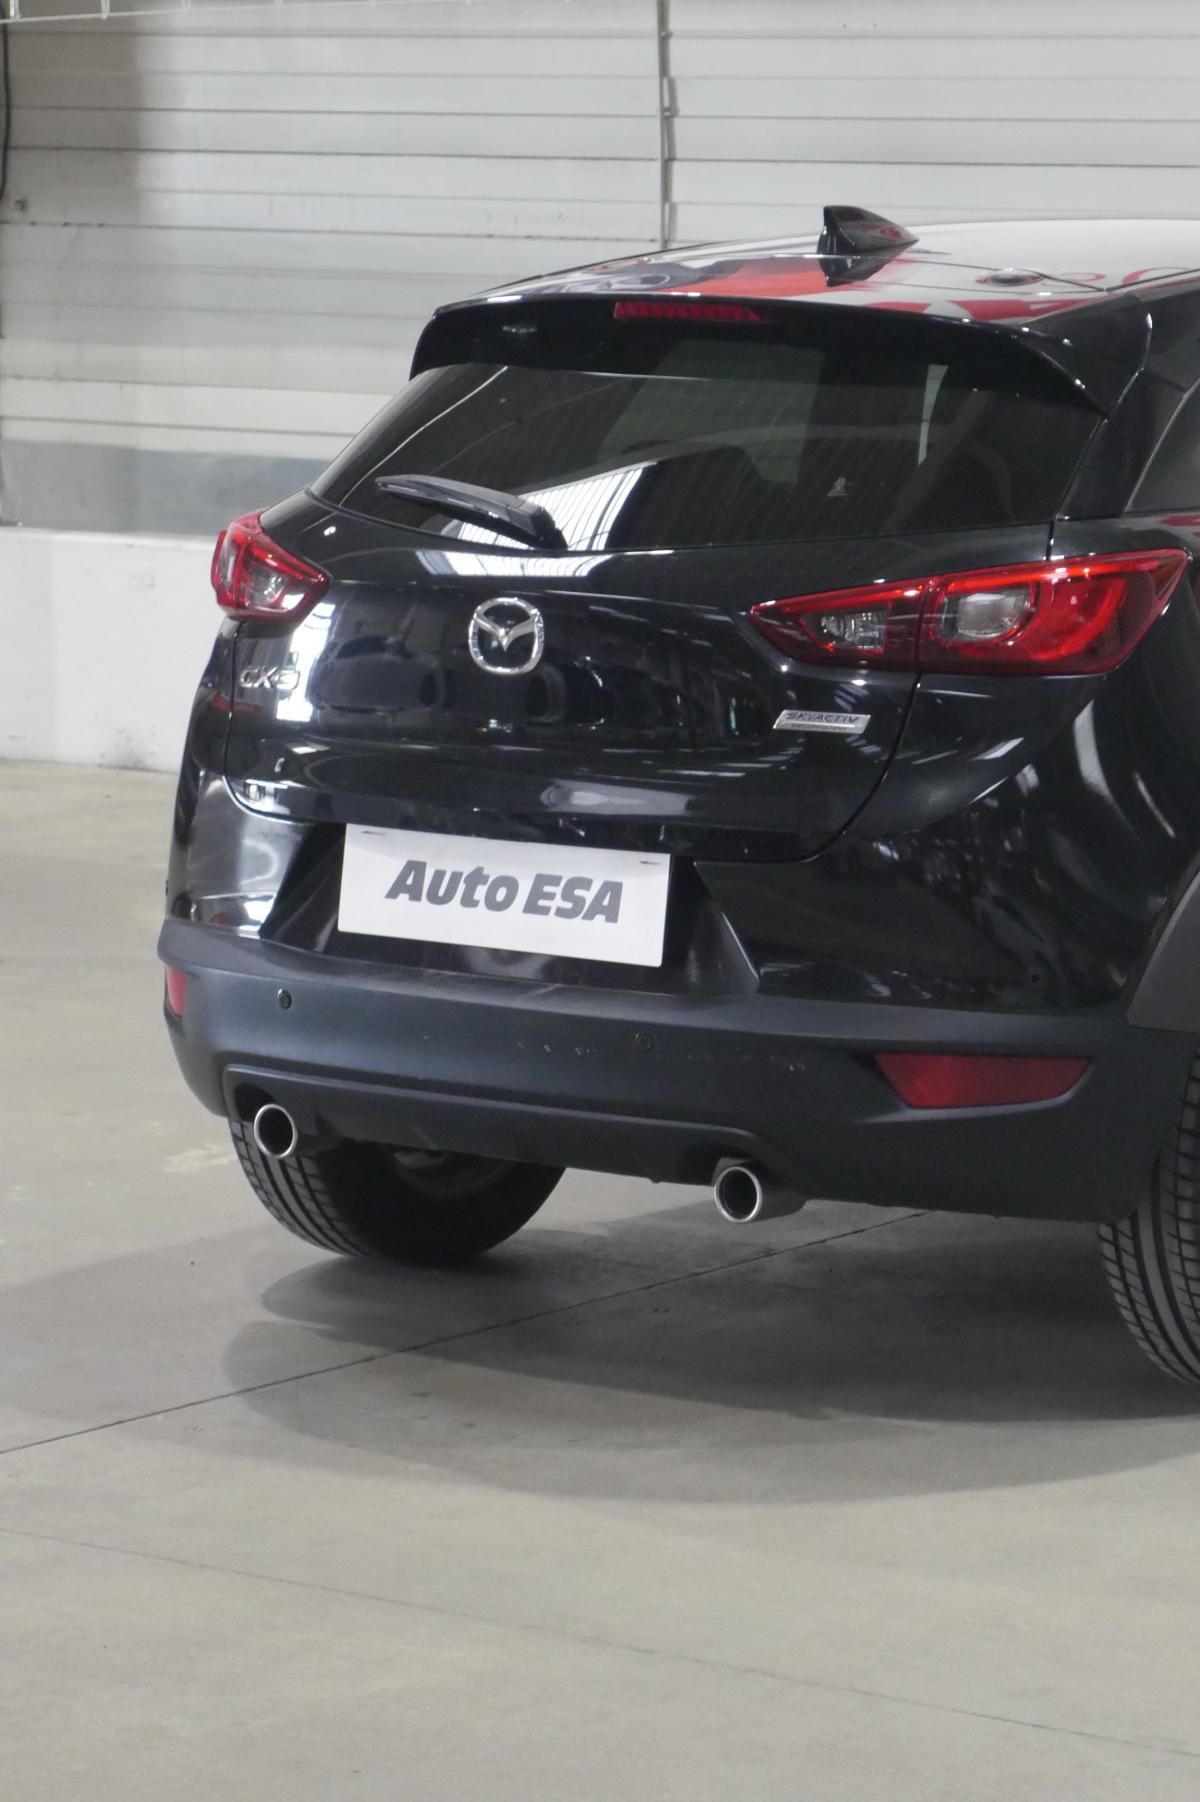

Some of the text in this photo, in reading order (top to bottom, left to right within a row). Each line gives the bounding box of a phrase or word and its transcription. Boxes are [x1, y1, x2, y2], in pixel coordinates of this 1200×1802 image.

[785, 711, 860, 723] SKYACTIV
[385, 860, 624, 924] Auto ESA
